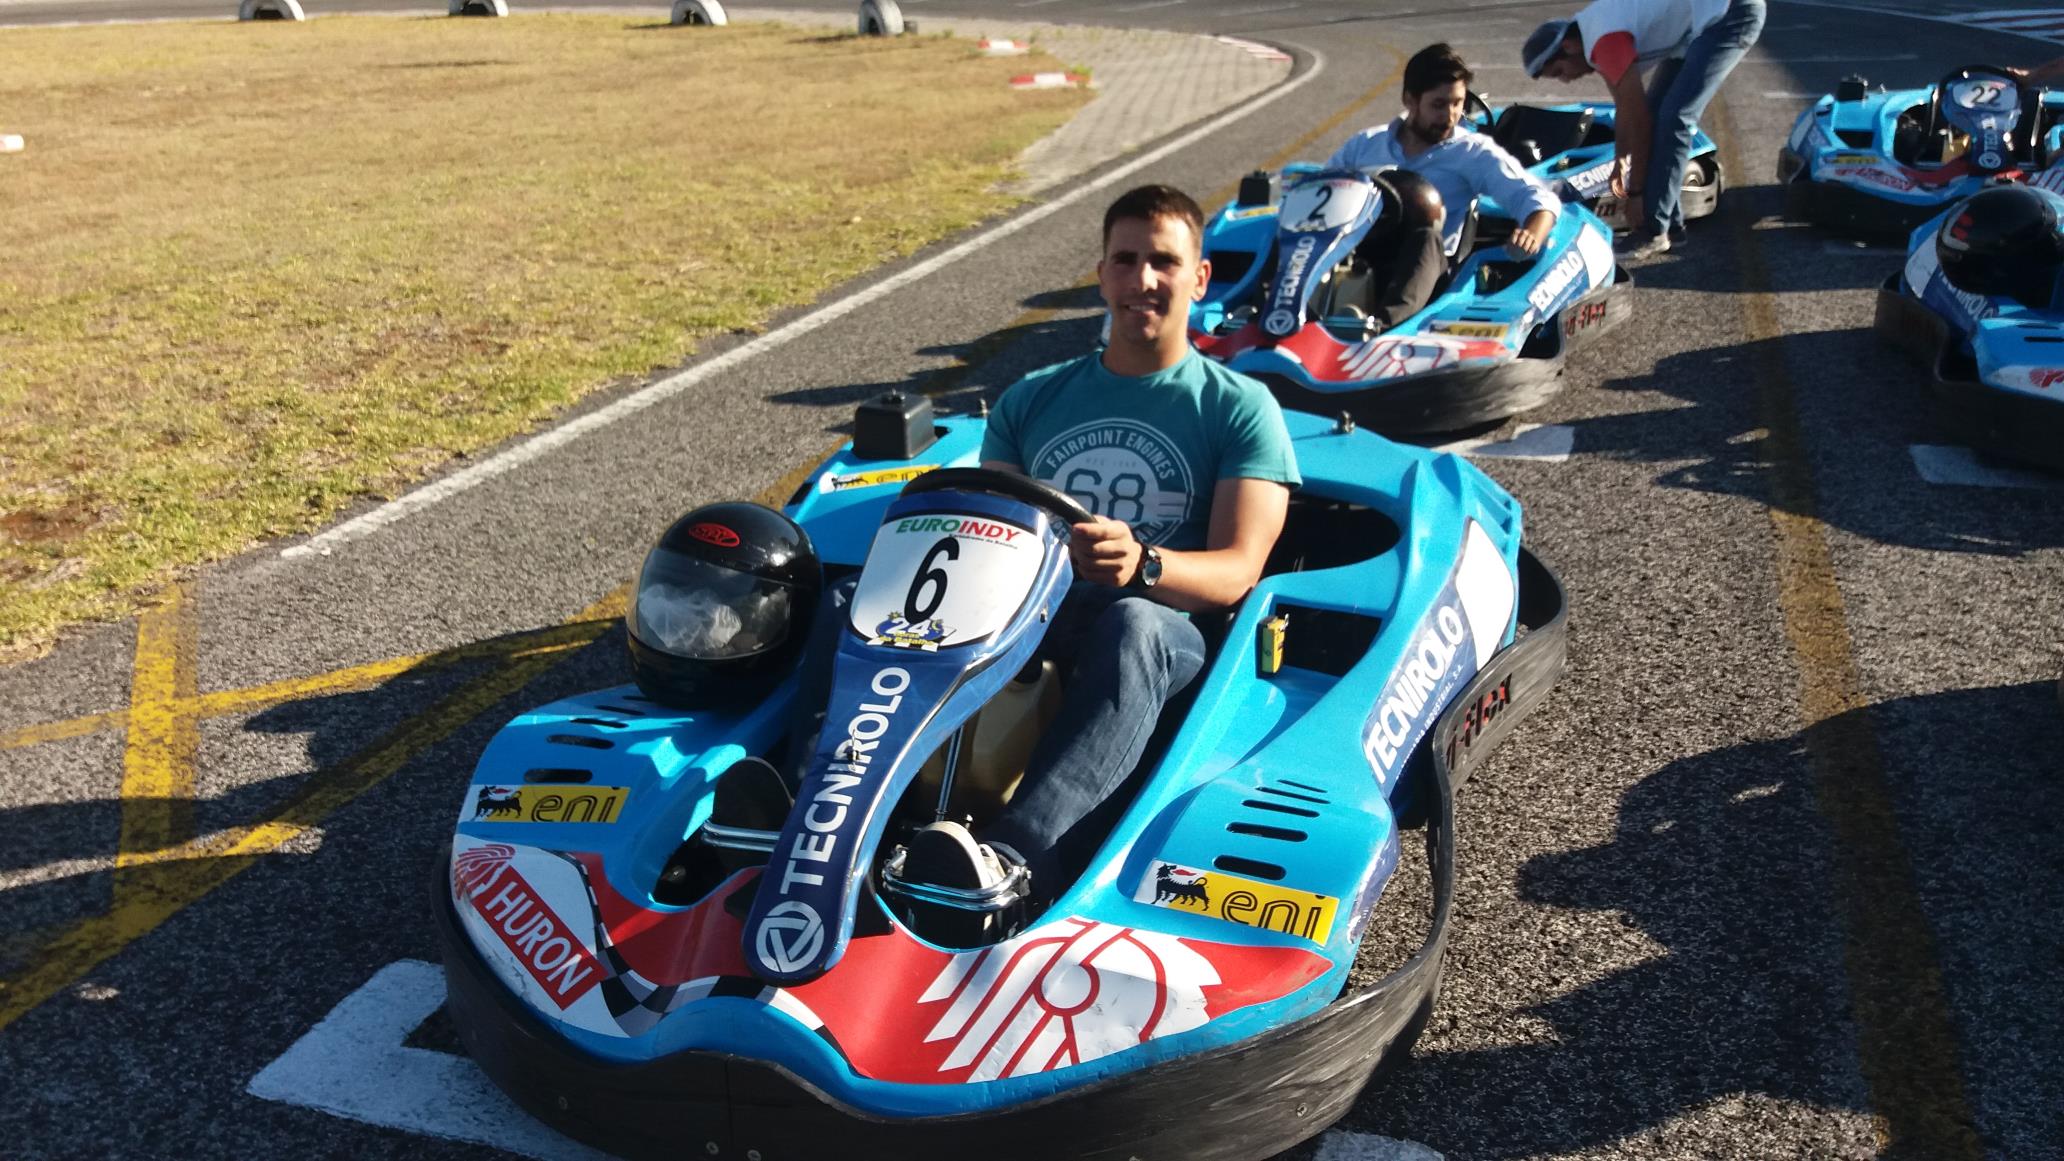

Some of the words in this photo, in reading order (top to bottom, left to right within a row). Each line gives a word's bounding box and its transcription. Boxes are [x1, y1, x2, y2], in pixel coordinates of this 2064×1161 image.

[1971, 86, 2000, 106] 22
[1307, 185, 1333, 222] 2
[1275, 236, 1316, 308] TECNIROLO
[1046, 430, 1124, 469] FAIRPOINT
[1126, 432, 1175, 480] ENGINES
[1064, 468, 1147, 522] 68
[896, 518, 1020, 541] EUROINDY
[904, 536, 960, 625] 6
[885, 616, 931, 636] 24
[1363, 605, 1464, 784] TECNIROLO
[530, 786, 620, 823] eni
[780, 666, 911, 894] TECNIROLO
[485, 880, 593, 996] HURON
[1221, 890, 1325, 940] eni
